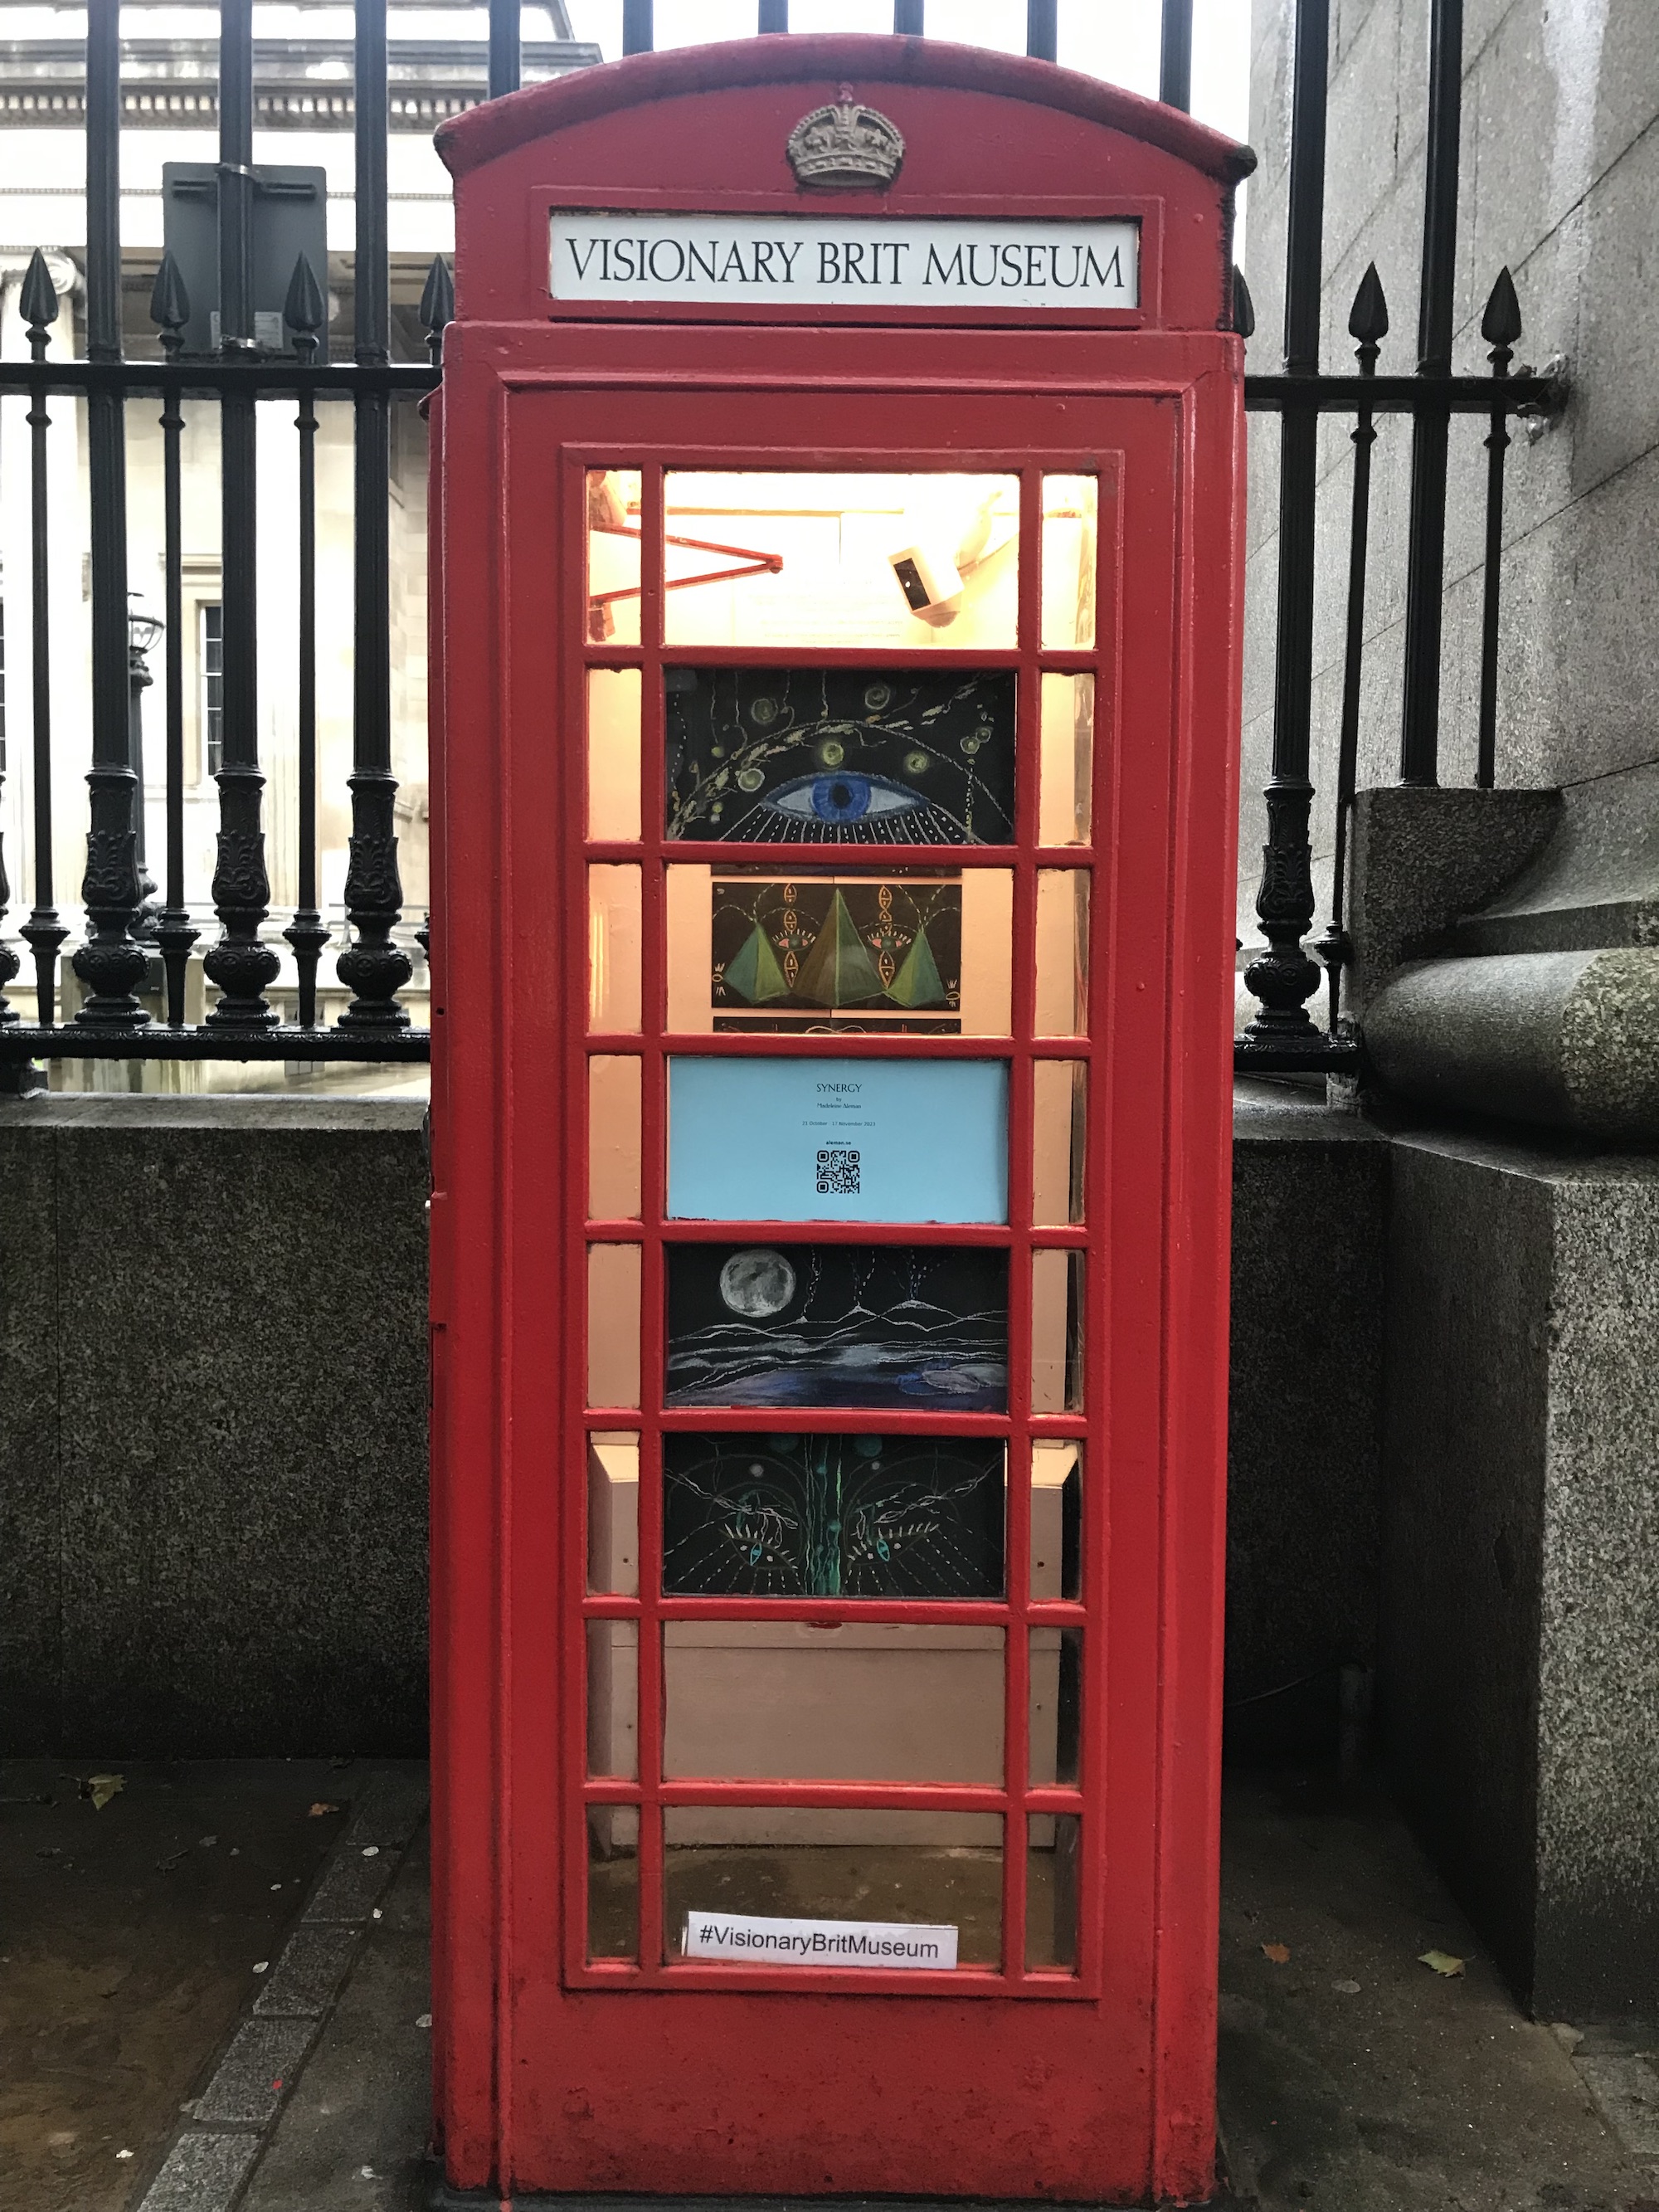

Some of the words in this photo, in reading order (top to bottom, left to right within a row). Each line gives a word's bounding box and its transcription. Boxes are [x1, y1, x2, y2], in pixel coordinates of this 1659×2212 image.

[565, 237, 805, 284] VISIONARY
[816, 241, 910, 285] BRIT
[922, 242, 1126, 288] MUSEUM
[816, 1083, 863, 1093] SYNERGY
[699, 1924, 938, 1959] #VisionaryBritMuseum
